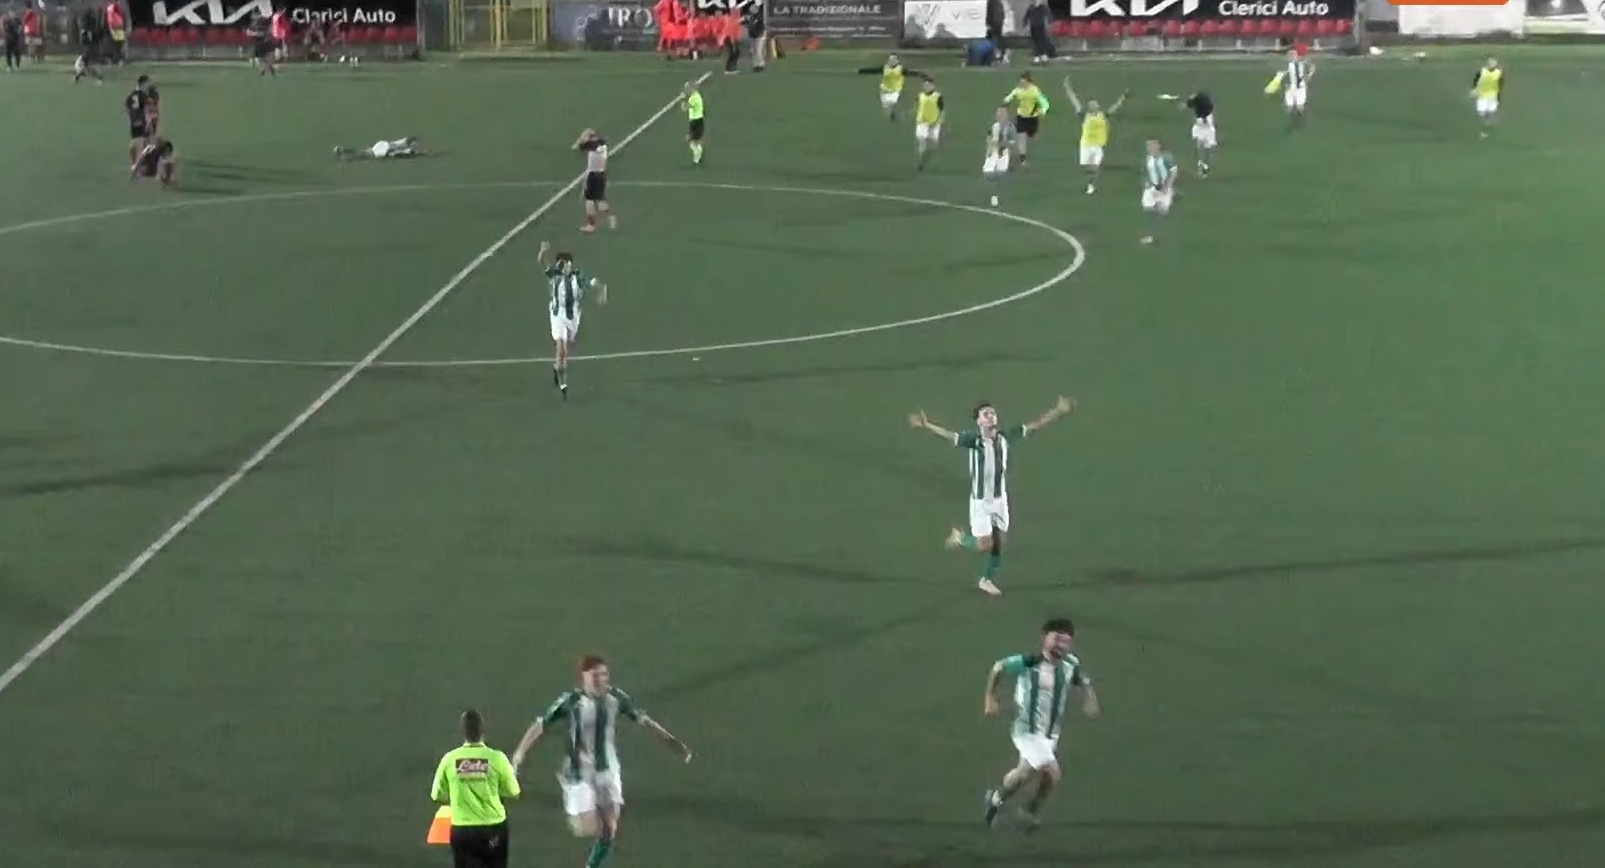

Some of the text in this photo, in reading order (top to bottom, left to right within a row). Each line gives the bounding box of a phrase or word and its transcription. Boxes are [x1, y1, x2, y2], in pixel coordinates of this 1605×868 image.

[352, 7, 396, 23] Auto
[1218, 0, 1329, 16] Clerici Auto
